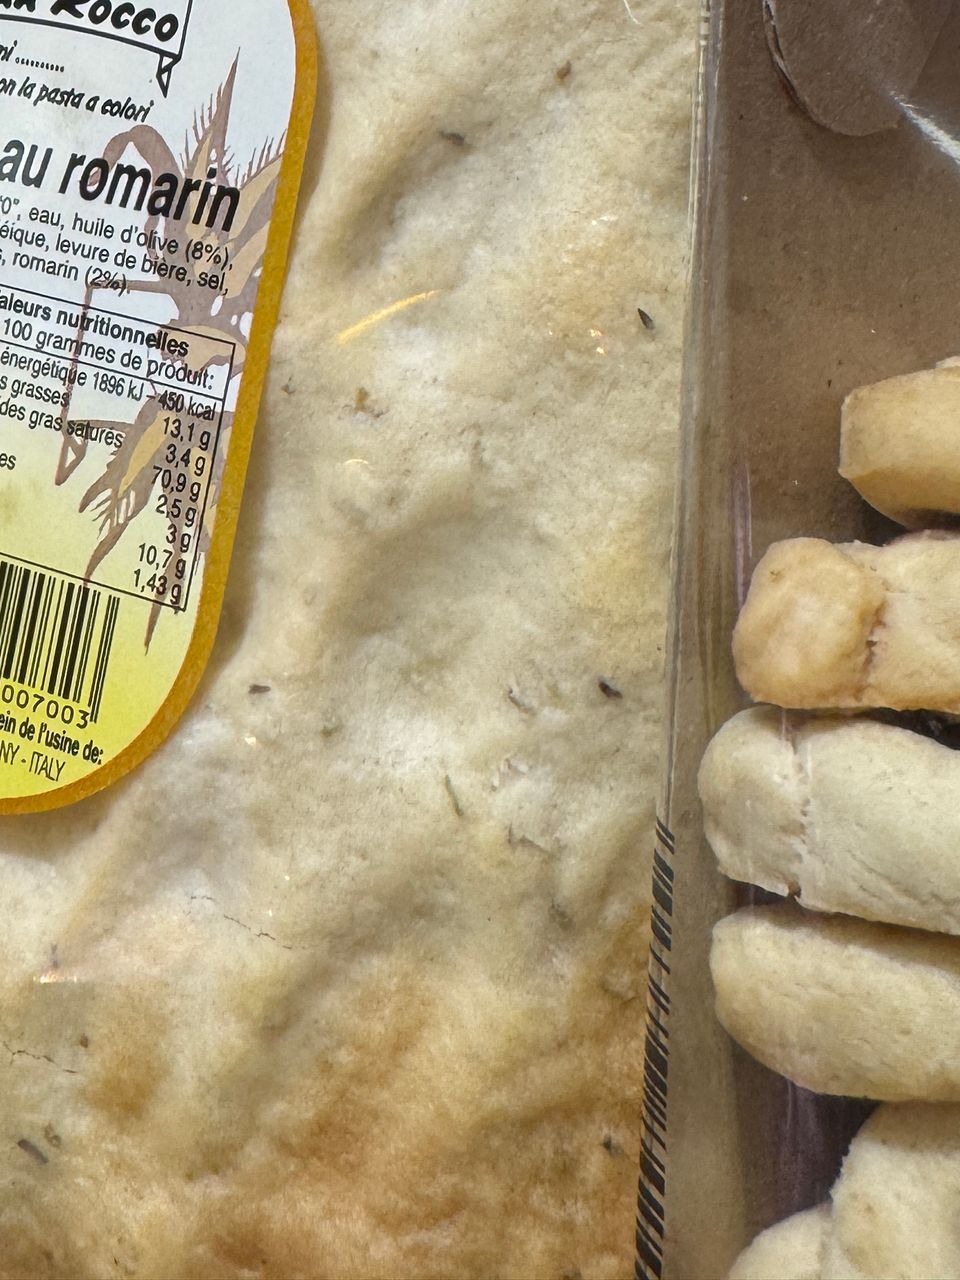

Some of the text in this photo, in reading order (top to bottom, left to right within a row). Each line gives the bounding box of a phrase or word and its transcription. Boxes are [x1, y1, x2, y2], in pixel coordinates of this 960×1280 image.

[18, 77, 36, 99] la
[33, 83, 85, 108] pasta
[86, 96, 100, 112] a
[101, 97, 154, 122] colori
[58, 152, 240, 232] romarin
[29, 207, 64, 230] eau,
[72, 213, 114, 238] huile
[186, 239, 233, 270] (8%),
[13, 251, 78, 281] romarin
[56, 233, 109, 263] levure
[114, 249, 137, 269] de
[141, 254, 191, 286] bière,
[197, 272, 228, 295] sel,
[3, 318, 32, 341] 100
[35, 328, 116, 365] grammes
[121, 350, 142, 371] de
[146, 359, 214, 390] produit:
[56, 310, 189, 358] nutritionnelles
[0, 346, 87, 386] énergétique
[93, 372, 124, 396] 1896
[127, 379, 144, 402] kJ
[157, 389, 185, 413] 450
[187, 396, 217, 422] kcal
[11, 377, 70, 408] grasses
[199, 431, 211, 451] g
[28, 407, 63, 432] gras
[165, 443, 191, 468] 3,4
[194, 456, 206, 477] g
[151, 465, 187, 494] 70,9
[189, 482, 201, 503] g
[155, 494, 182, 518] 2,5
[185, 507, 197, 528] g
[138, 543, 173, 571] 10,7
[175, 559, 187, 580] g
[165, 524, 178, 544] 3
[180, 533, 192, 553] g
[133, 568, 168, 596] 1,43
[170, 584, 182, 605] g
[1, 684, 90, 729] 007003
[19, 717, 35, 741] de
[83, 740, 104, 764] de:
[29, 751, 66, 782] ITALY
